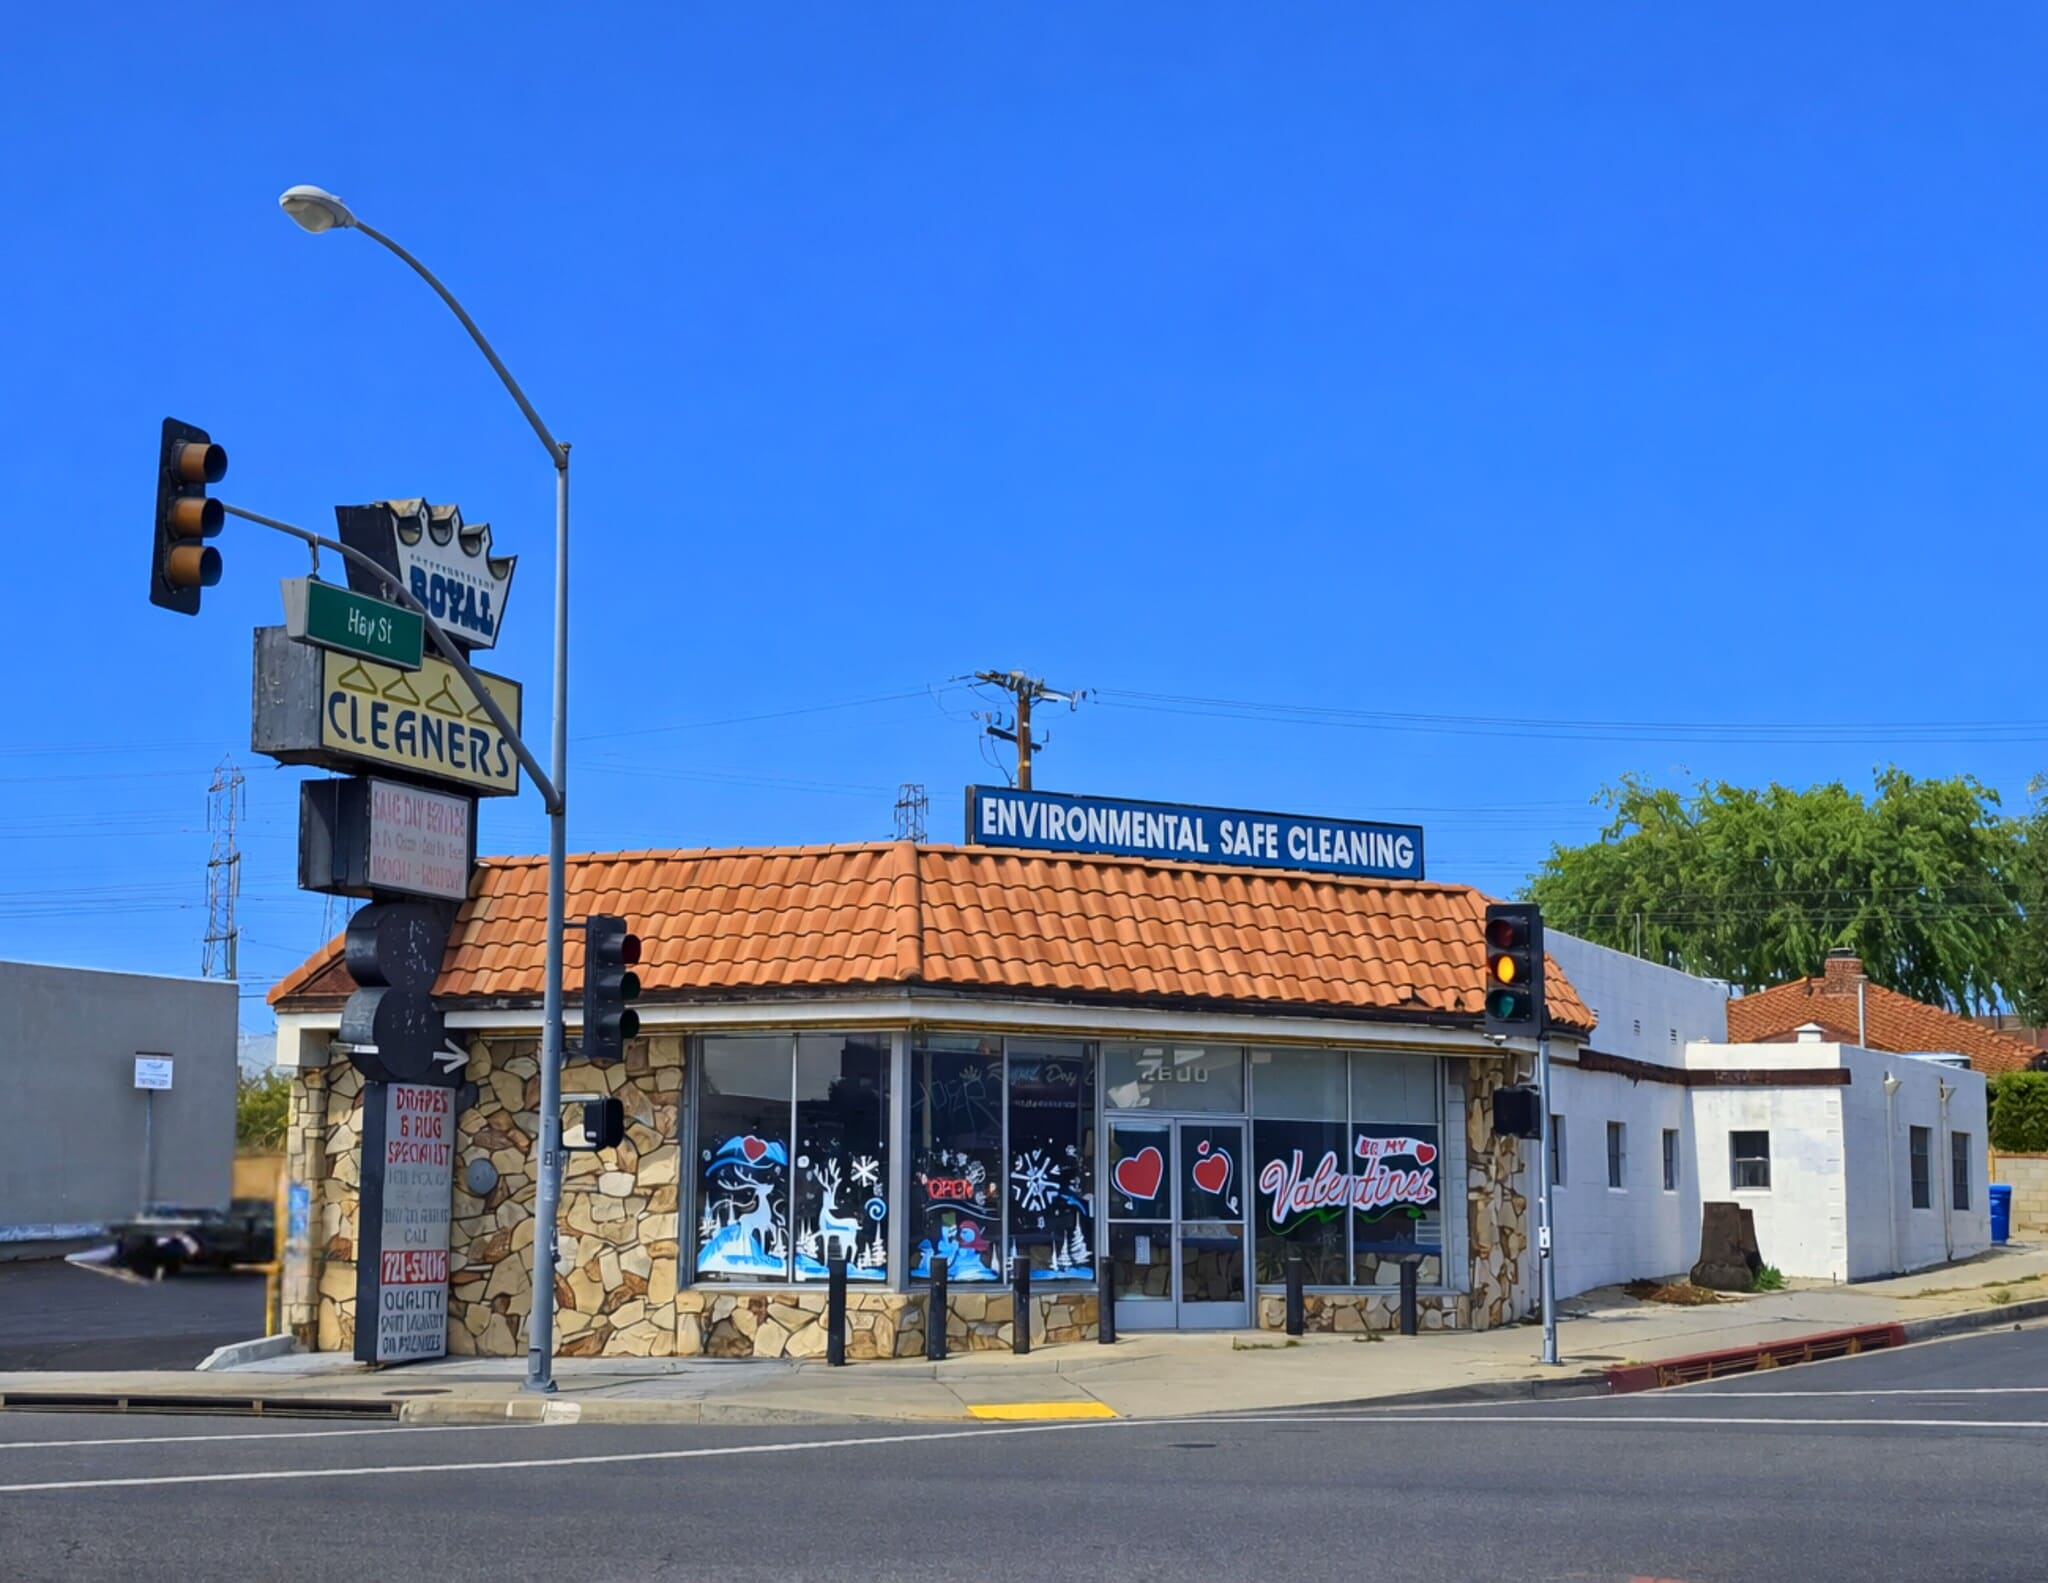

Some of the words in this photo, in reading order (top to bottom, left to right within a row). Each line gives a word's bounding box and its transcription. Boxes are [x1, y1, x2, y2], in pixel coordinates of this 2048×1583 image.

[348, 607, 373, 644] Hay
[377, 619, 393, 645] St
[410, 565, 494, 637] ROYAL
[328, 691, 511, 779] CLEANERS
[981, 796, 1209, 854] ENVIRONMENTAL
[1220, 819, 1278, 859] SAFE
[1287, 825, 1415, 869] CLEANING
[1384, 1139, 1407, 1154] MY
[384, 1290, 441, 1312] QUALITY
